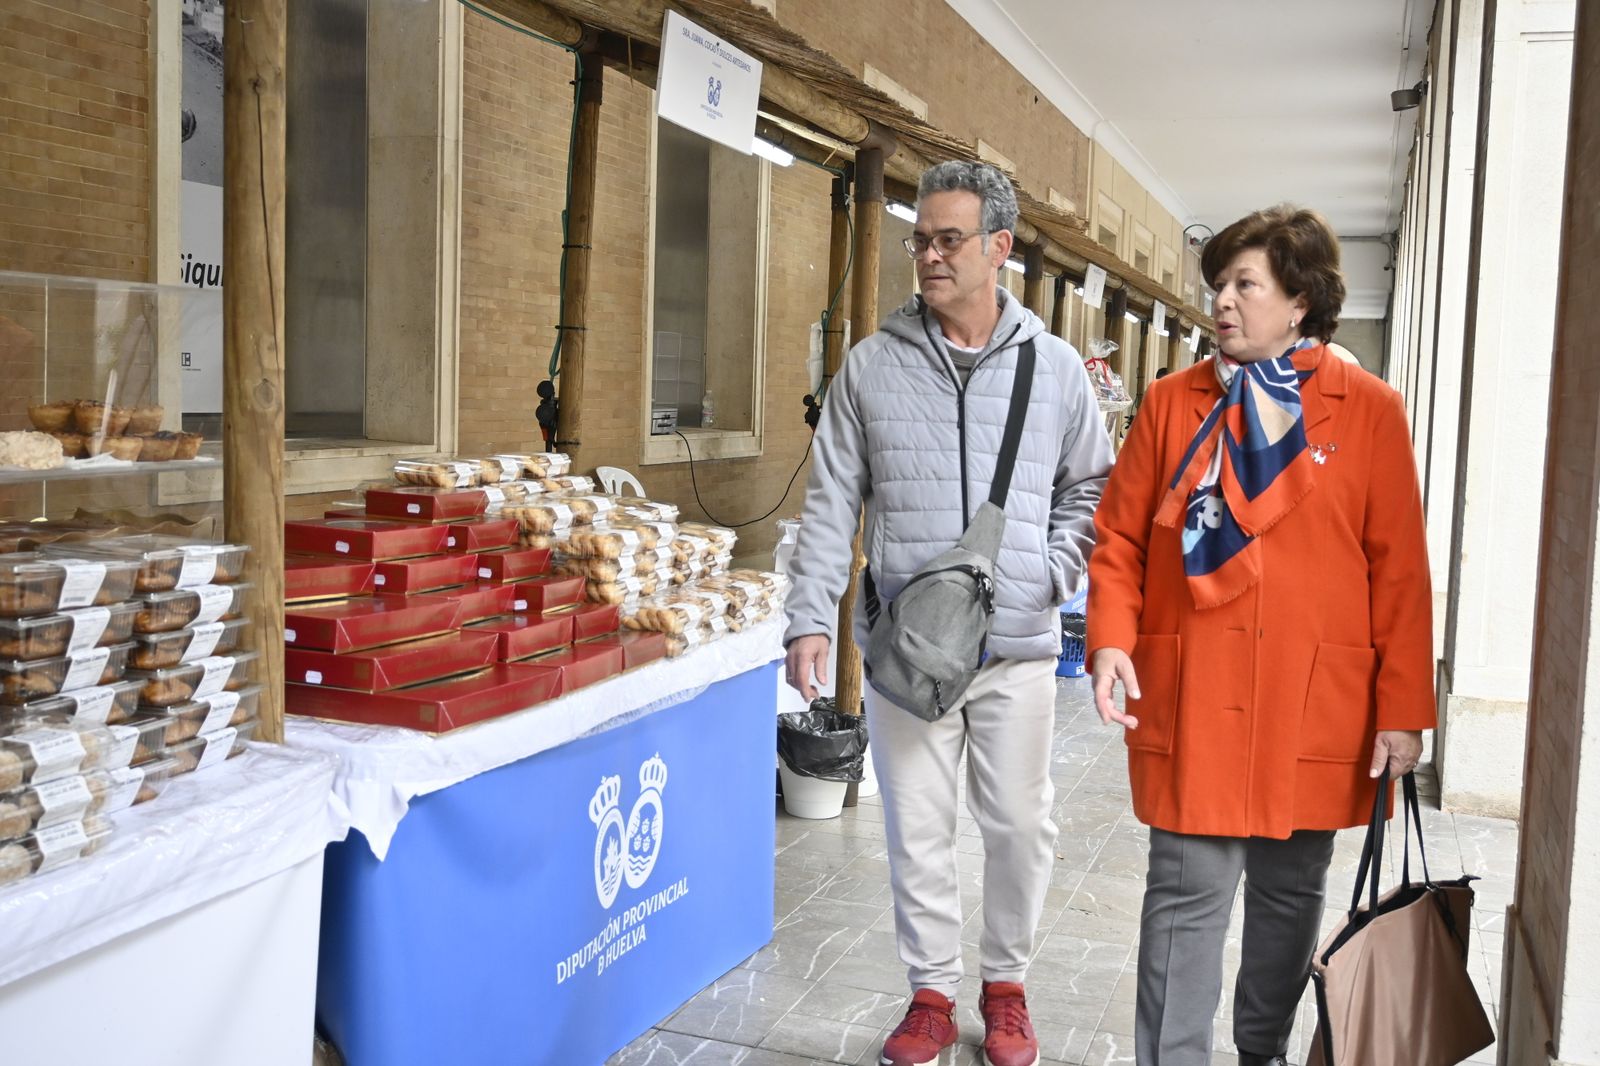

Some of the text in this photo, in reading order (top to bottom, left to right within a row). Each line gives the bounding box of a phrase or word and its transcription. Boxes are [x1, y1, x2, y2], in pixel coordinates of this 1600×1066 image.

[705, 40, 717, 54] COCAS
[720, 48, 732, 62] DULCES
[733, 56, 752, 72] ARTESANOS
[556, 876, 689, 984] DIPUTACIÓN PROVINCIAL
[605, 924, 646, 968] HUELVA
